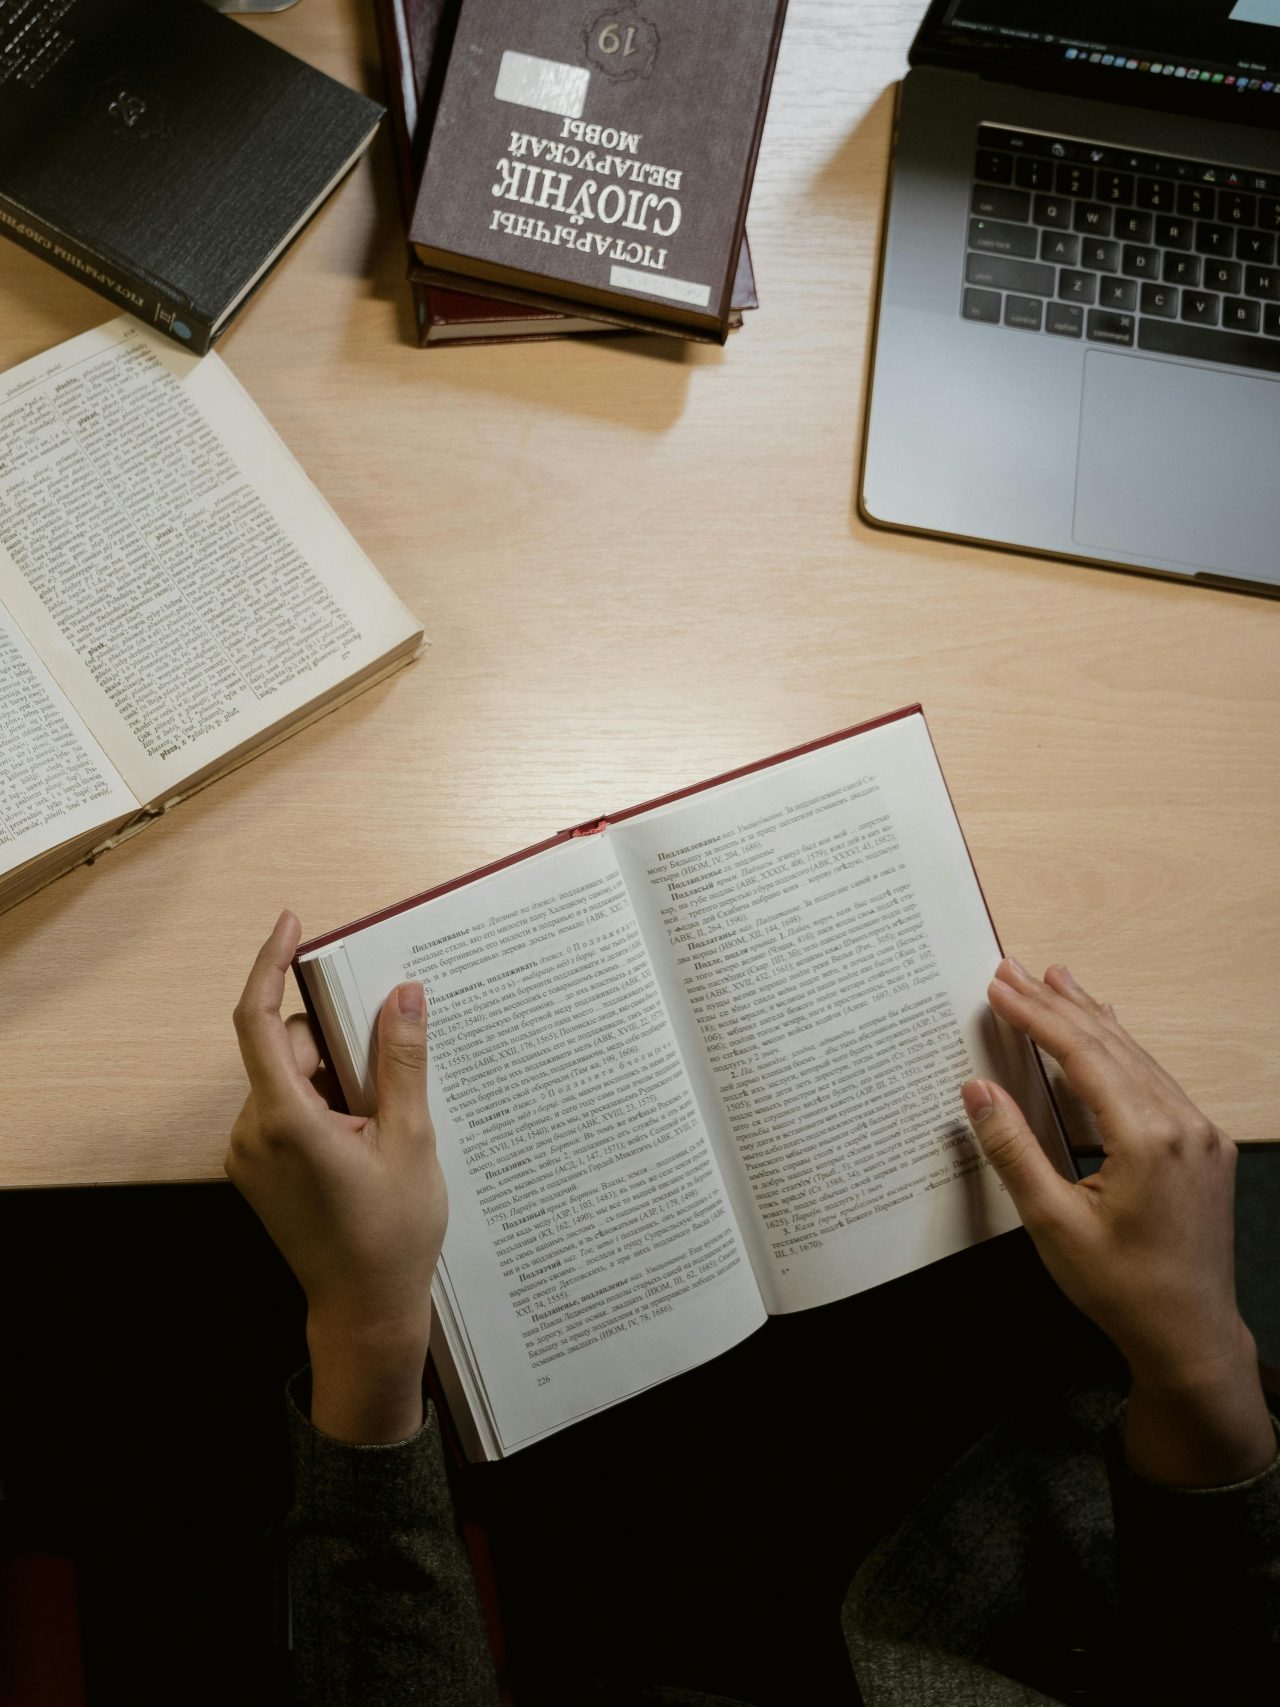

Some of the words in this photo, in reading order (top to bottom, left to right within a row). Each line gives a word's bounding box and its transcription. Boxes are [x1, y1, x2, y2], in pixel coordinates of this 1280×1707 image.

[597, 23, 635, 57] 19
[559, 117, 641, 154] МОВЫ
[507, 130, 683, 191] БЕЛАРУСКАЙ
[1031, 173, 1037, 184] 1
[1071, 181, 1079, 191] 2
[491, 157, 682, 237] СЛОЎНІК
[1111, 188, 1119, 198] 3
[1151, 195, 1160, 204] 4
[1047, 205, 1057, 217] Q
[1192, 201, 1200, 212] 5
[1086, 212, 1099, 223] W
[1232, 208, 1241, 218] 6
[1129, 219, 1137, 231] E
[1169, 226, 1178, 237] R
[488, 209, 668, 270] ГІСТАРЫЧНЫ
[1211, 233, 1219, 244] T
[1055, 242, 1064, 253] A
[1251, 240, 1260, 251] Y
[1096, 248, 1105, 260] S
[1136, 255, 1146, 267] D
[1177, 262, 1185, 273] F
[1218, 269, 1227, 281] G
[1073, 279, 1082, 291] Z
[1259, 277, 1269, 287] H
[1113, 287, 1122, 298] X
[1154, 294, 1163, 305] C
[1196, 301, 1205, 312] V
[1237, 307, 1246, 319] B
[670, 881, 715, 902] Подласый
[411, 927, 470, 954] Подлаживанье
[686, 929, 737, 951] Подлатанье
[427, 980, 486, 1006] Подлаживати,
[485, 960, 538, 984] подлаживать
[467, 1107, 511, 1129] Подлазити
[484, 1157, 533, 1180] Подлазникъ
[501, 1207, 546, 1231] Подлазный
[518, 1258, 562, 1283] Подлазчий
[536, 1374, 551, 1387] 226
